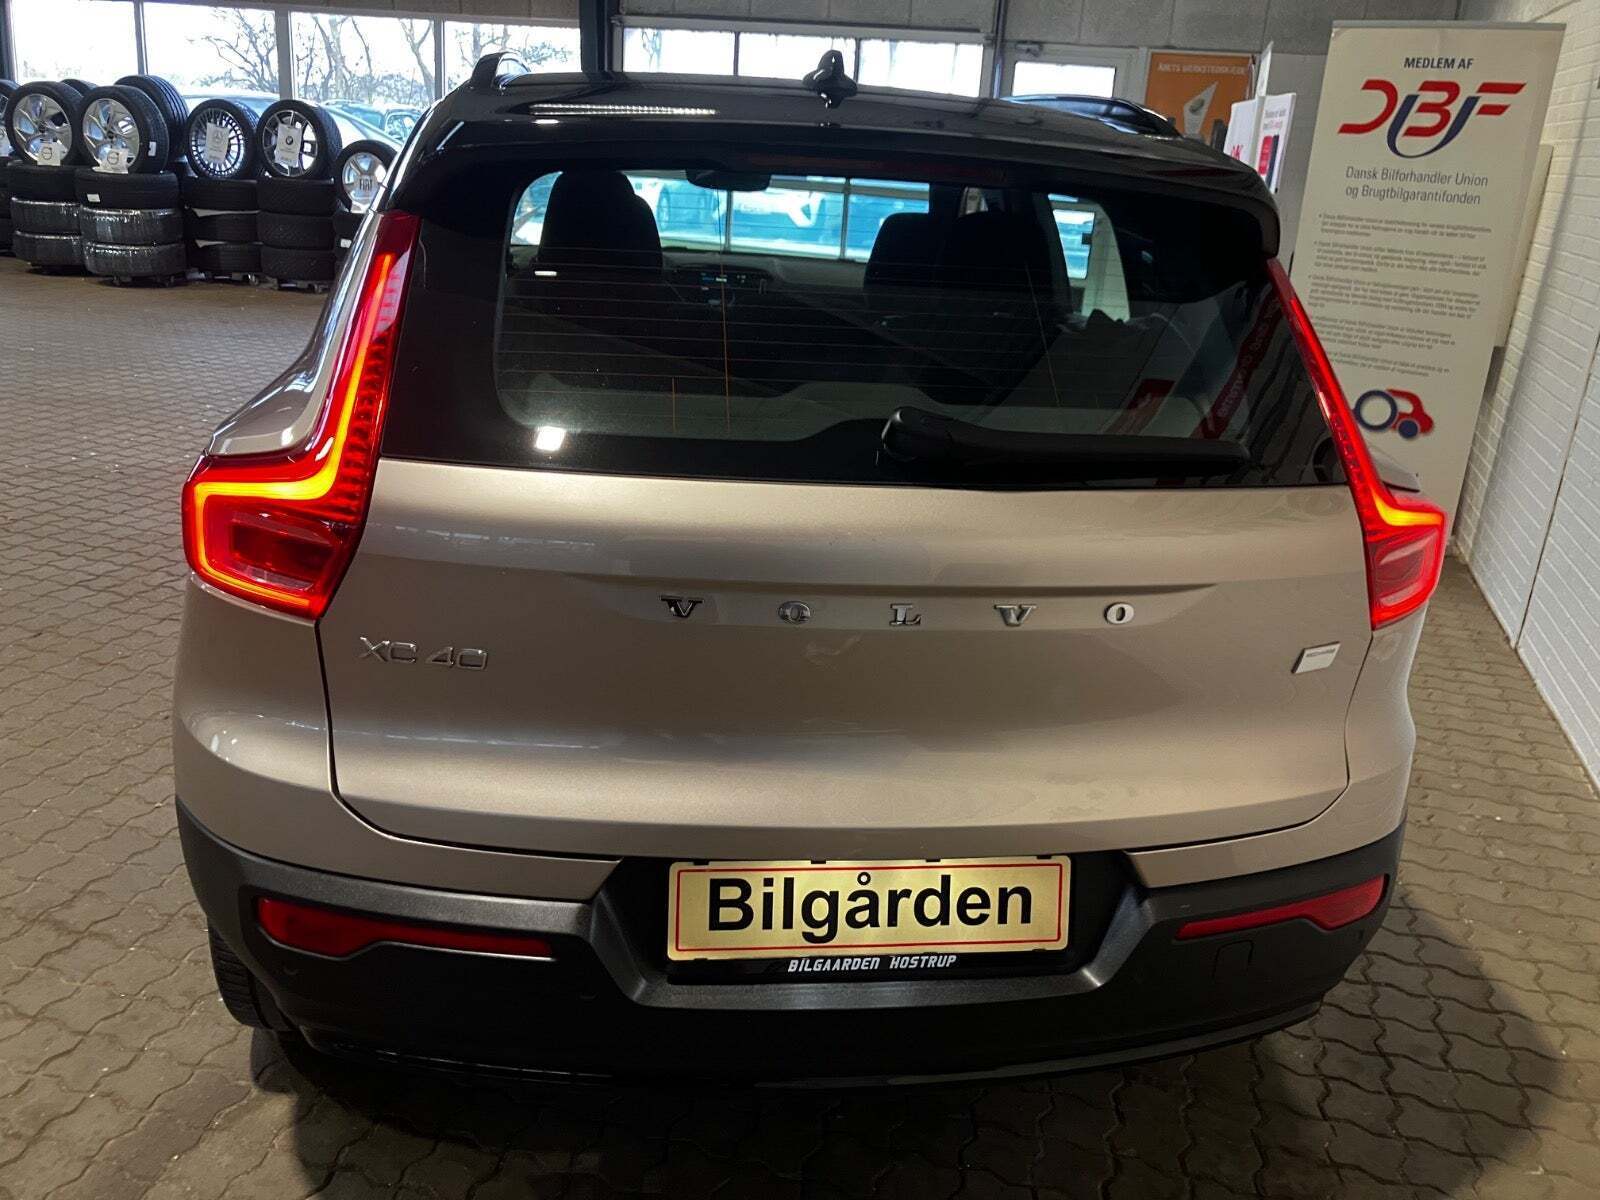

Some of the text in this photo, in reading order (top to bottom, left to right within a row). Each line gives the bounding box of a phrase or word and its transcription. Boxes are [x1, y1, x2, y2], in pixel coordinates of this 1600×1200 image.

[1403, 57, 1475, 69] MEDLEM AF
[1345, 165, 1489, 187] Dansk Bilforhandler Union
[1345, 184, 1481, 205] og Brugtbilgarantifonden
[660, 594, 1136, 627] VOLVO
[358, 636, 489, 672] XC 40
[707, 871, 1033, 944] Bilgården
[787, 953, 958, 973] BILGAARDEN HOSTRUP
